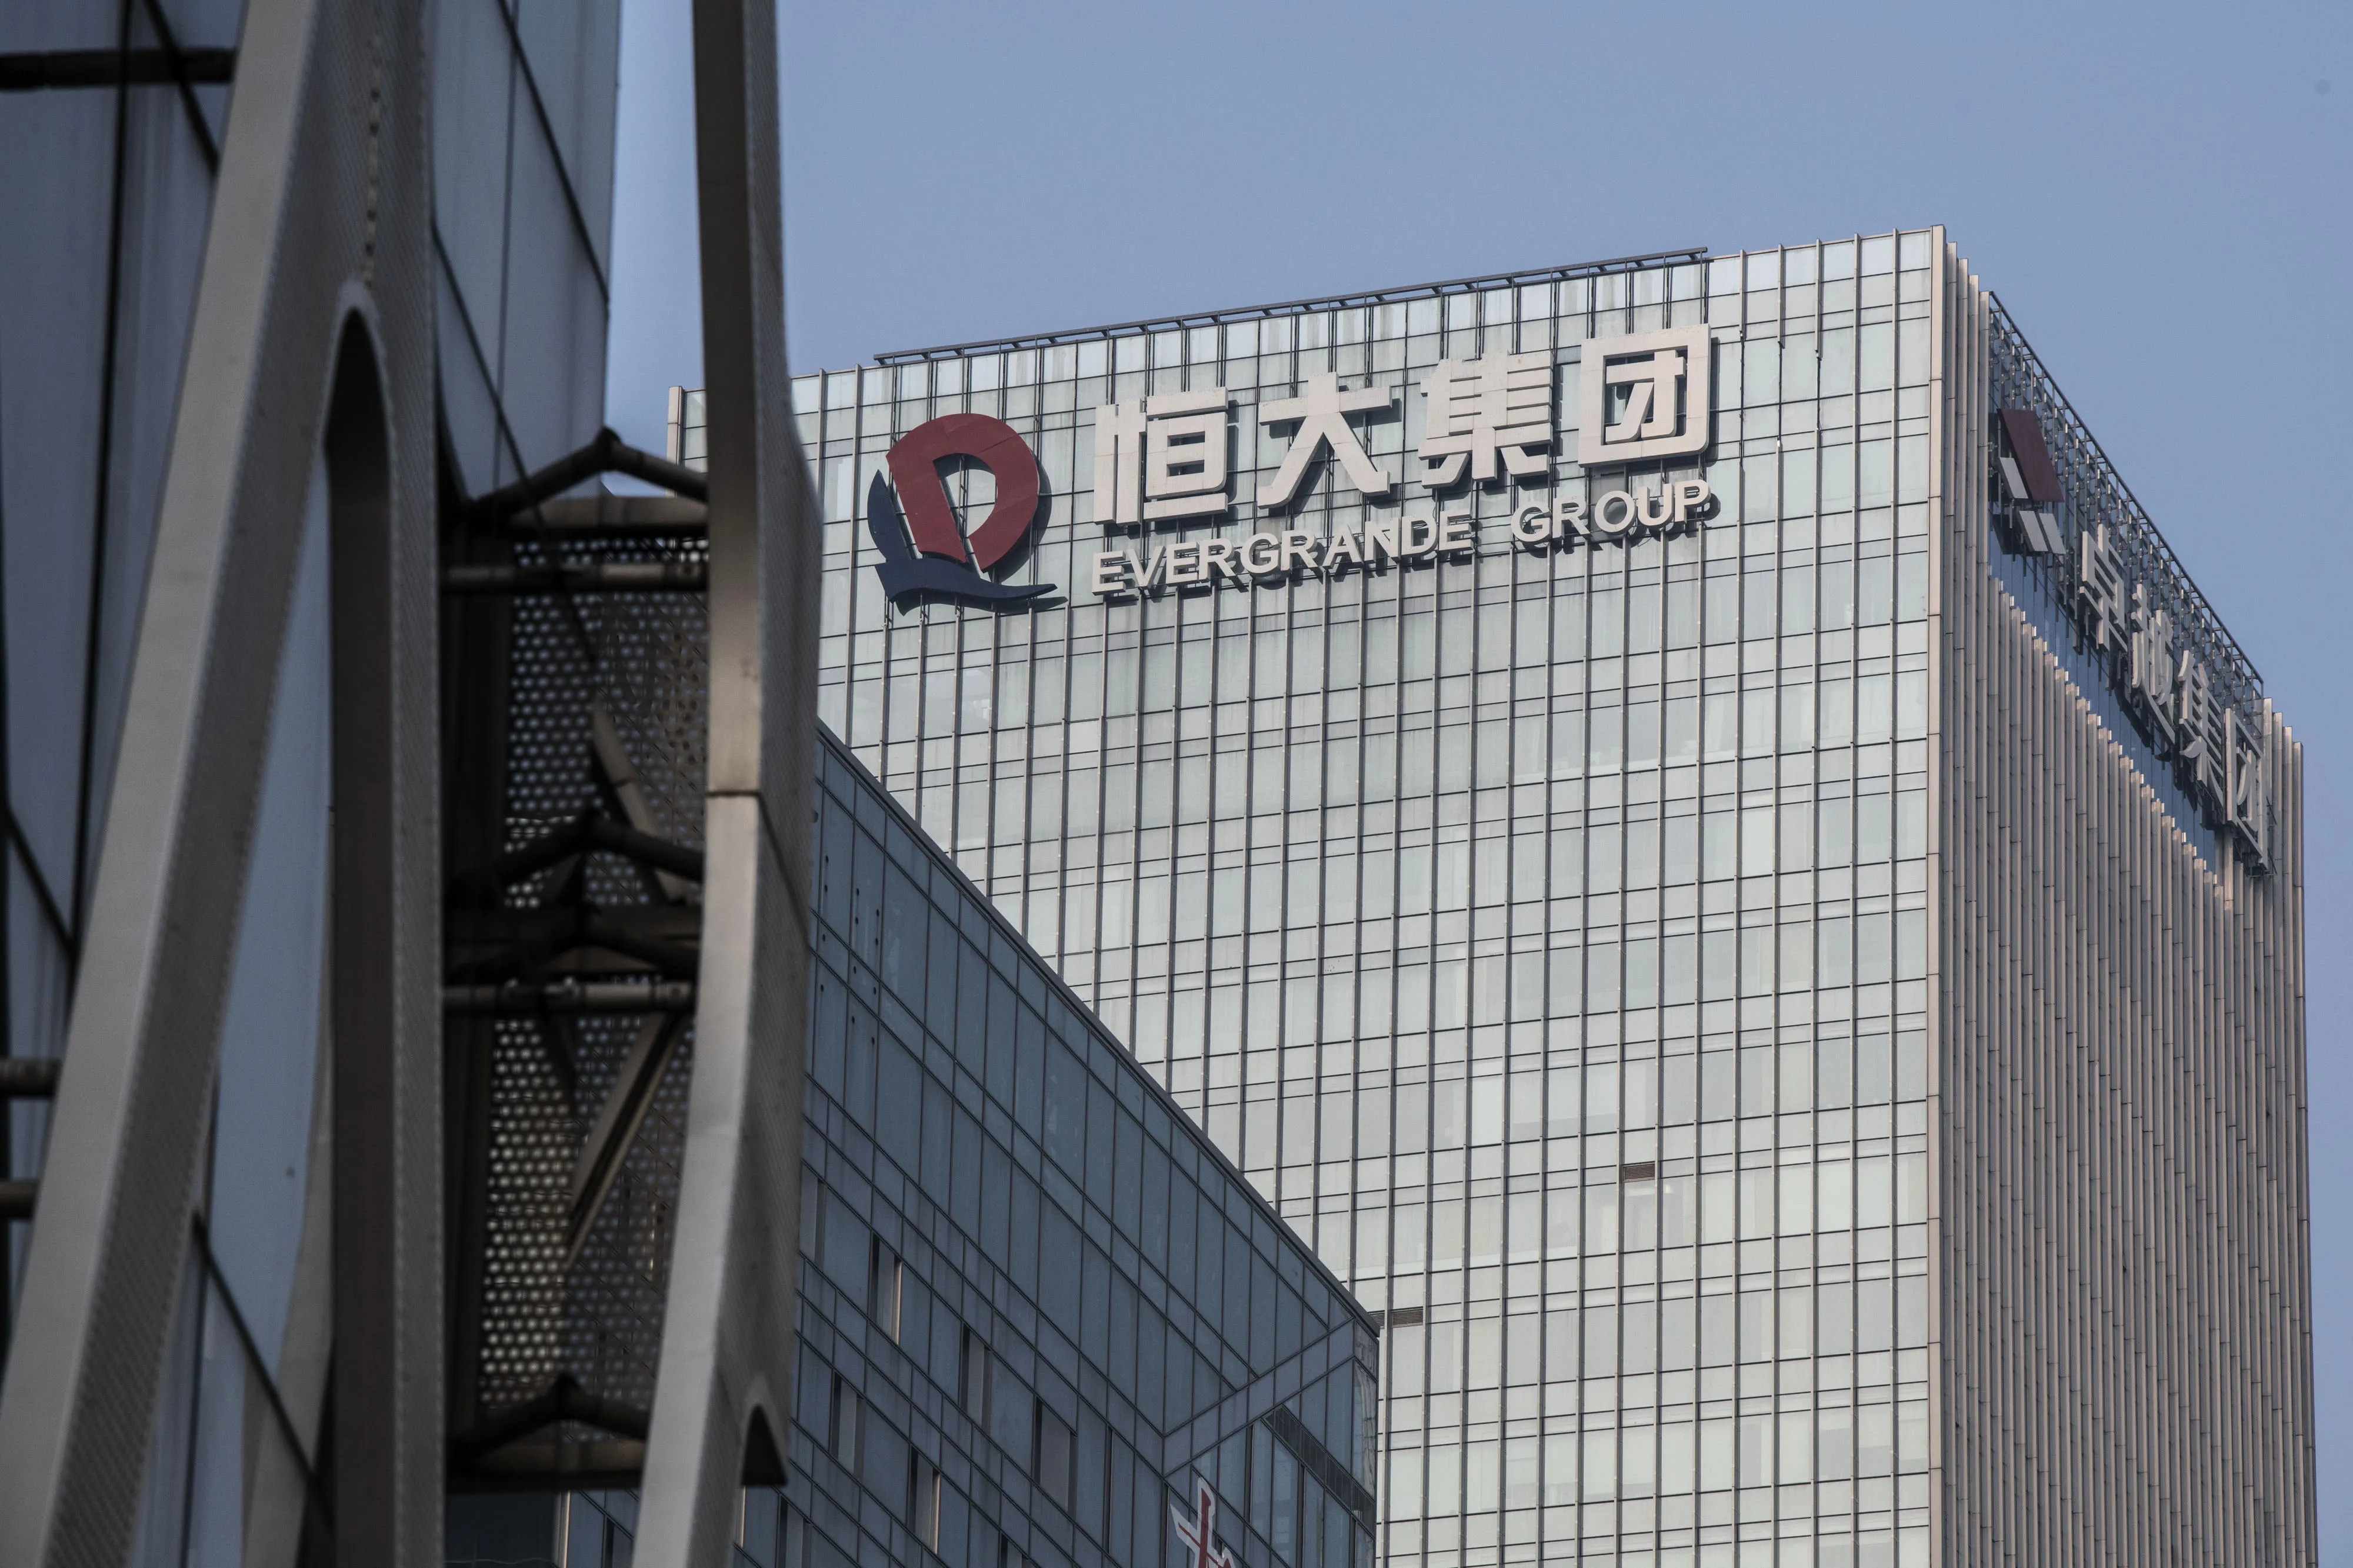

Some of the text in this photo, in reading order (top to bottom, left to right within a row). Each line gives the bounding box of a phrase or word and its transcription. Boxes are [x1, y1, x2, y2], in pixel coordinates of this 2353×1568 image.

[1093, 323, 1712, 525] 恒大集团
[1092, 479, 1712, 596] EVERGRANDE GROUP
